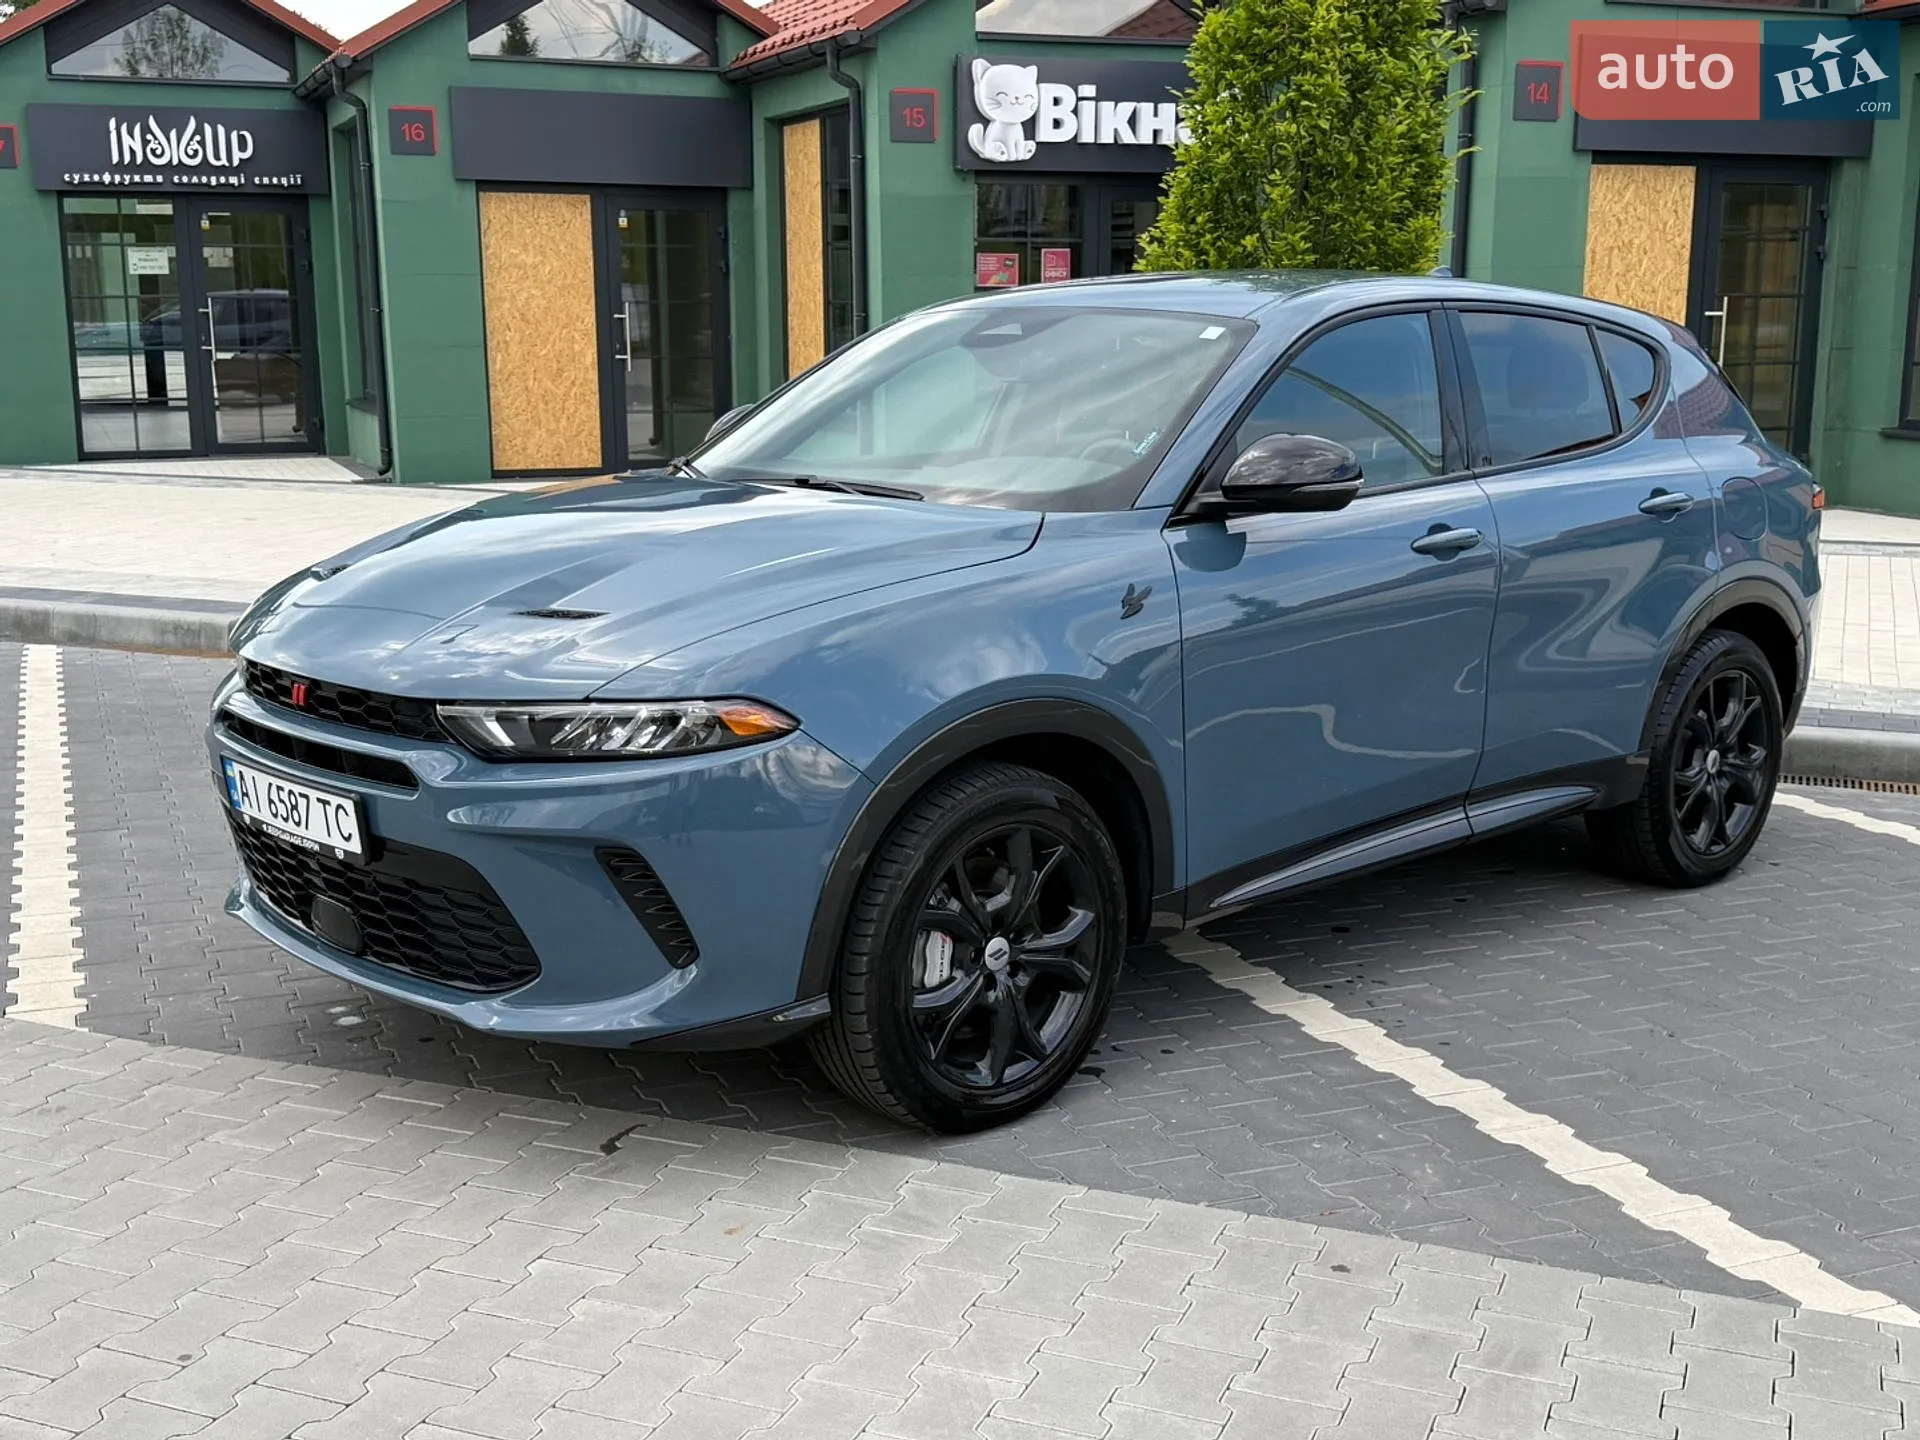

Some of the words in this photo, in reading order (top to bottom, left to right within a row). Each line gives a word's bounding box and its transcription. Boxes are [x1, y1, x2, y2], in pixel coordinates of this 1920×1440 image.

[1527, 82, 1550, 105] 14
[902, 107, 926, 129] 15
[401, 121, 426, 143] 16
[239, 769, 262, 813] AI
[266, 781, 311, 831] 6587
[316, 797, 353, 843] TC
